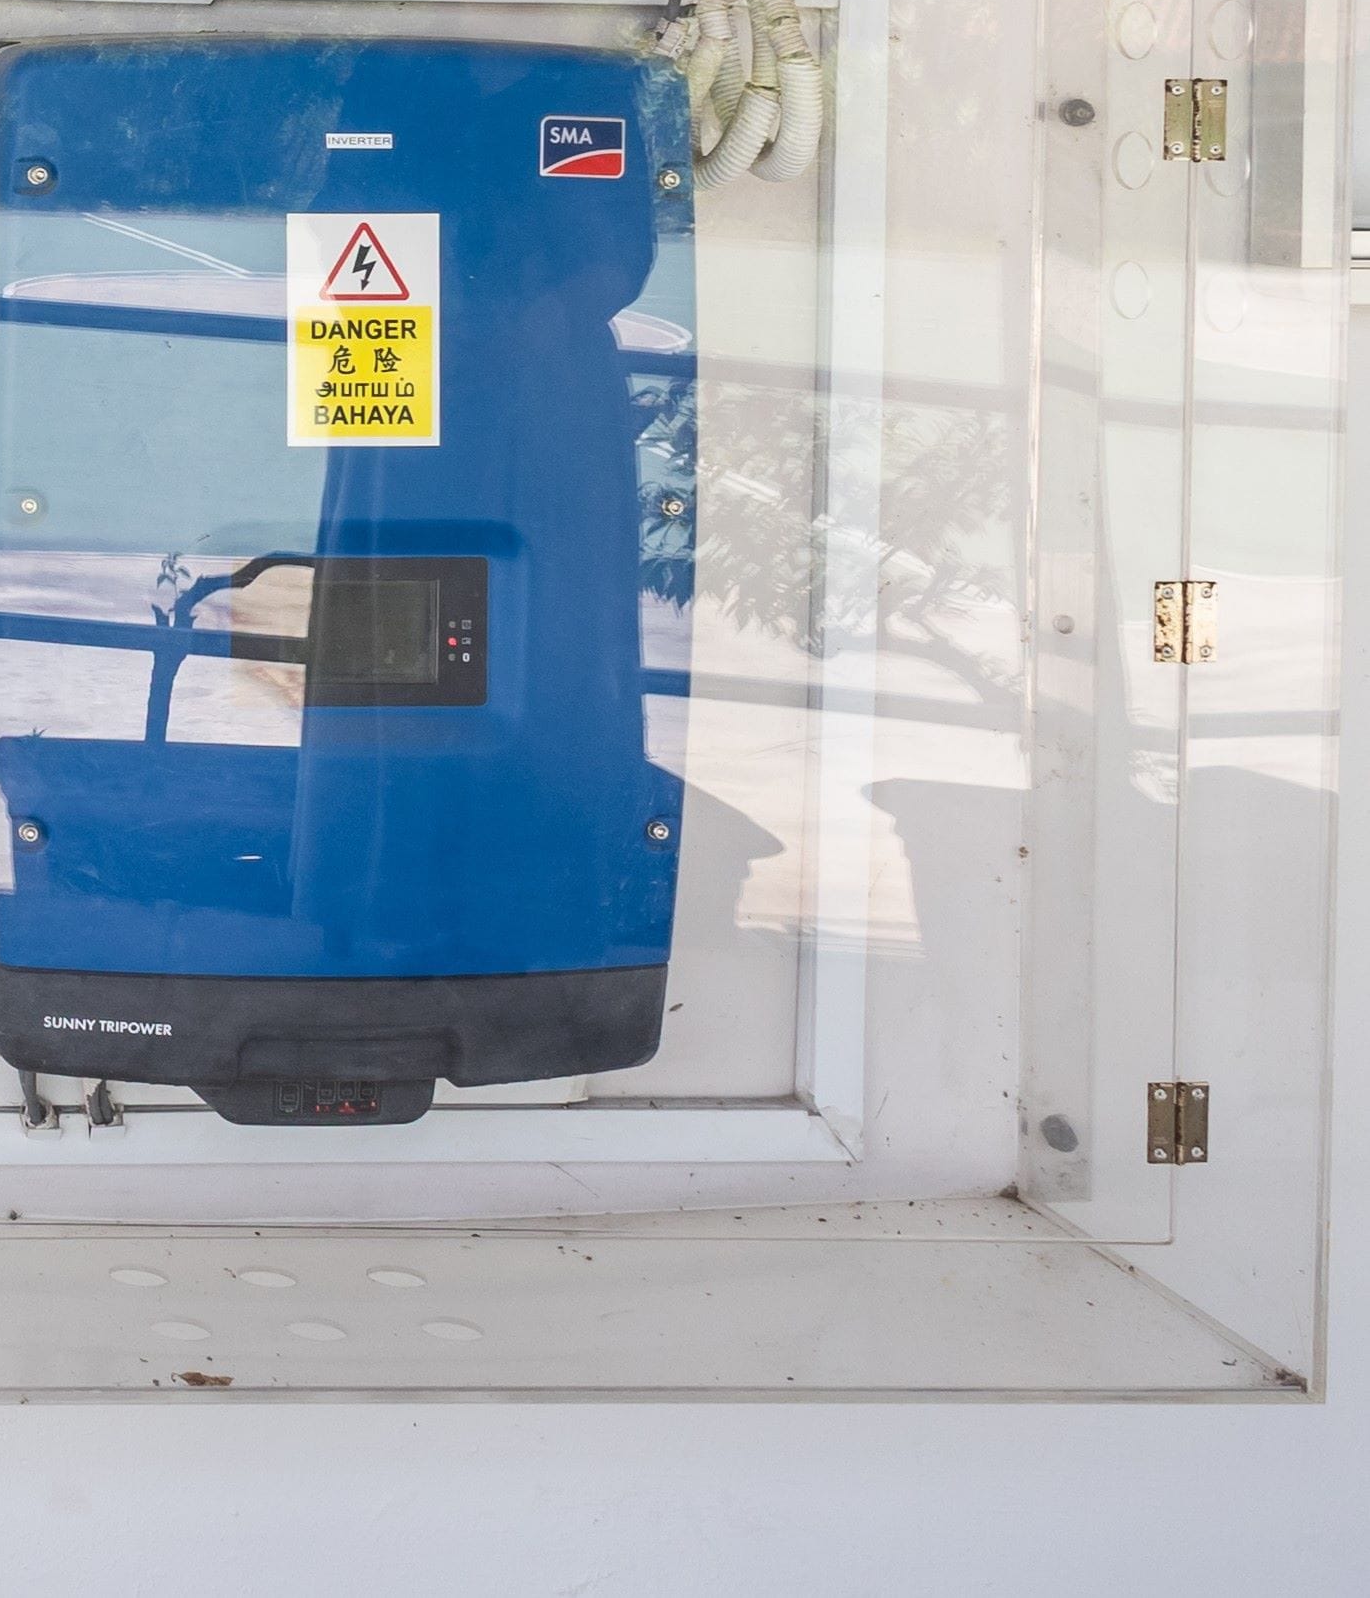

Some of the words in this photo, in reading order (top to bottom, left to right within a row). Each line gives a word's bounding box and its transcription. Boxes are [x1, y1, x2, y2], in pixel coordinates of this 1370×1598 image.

[327, 136, 392, 147] INVERTER
[550, 126, 592, 146] SMA
[310, 319, 417, 340] DANGER
[314, 405, 414, 426] BAHAYA
[43, 1016, 96, 1031] SUNNY
[99, 1020, 172, 1036] TRIPOWER
